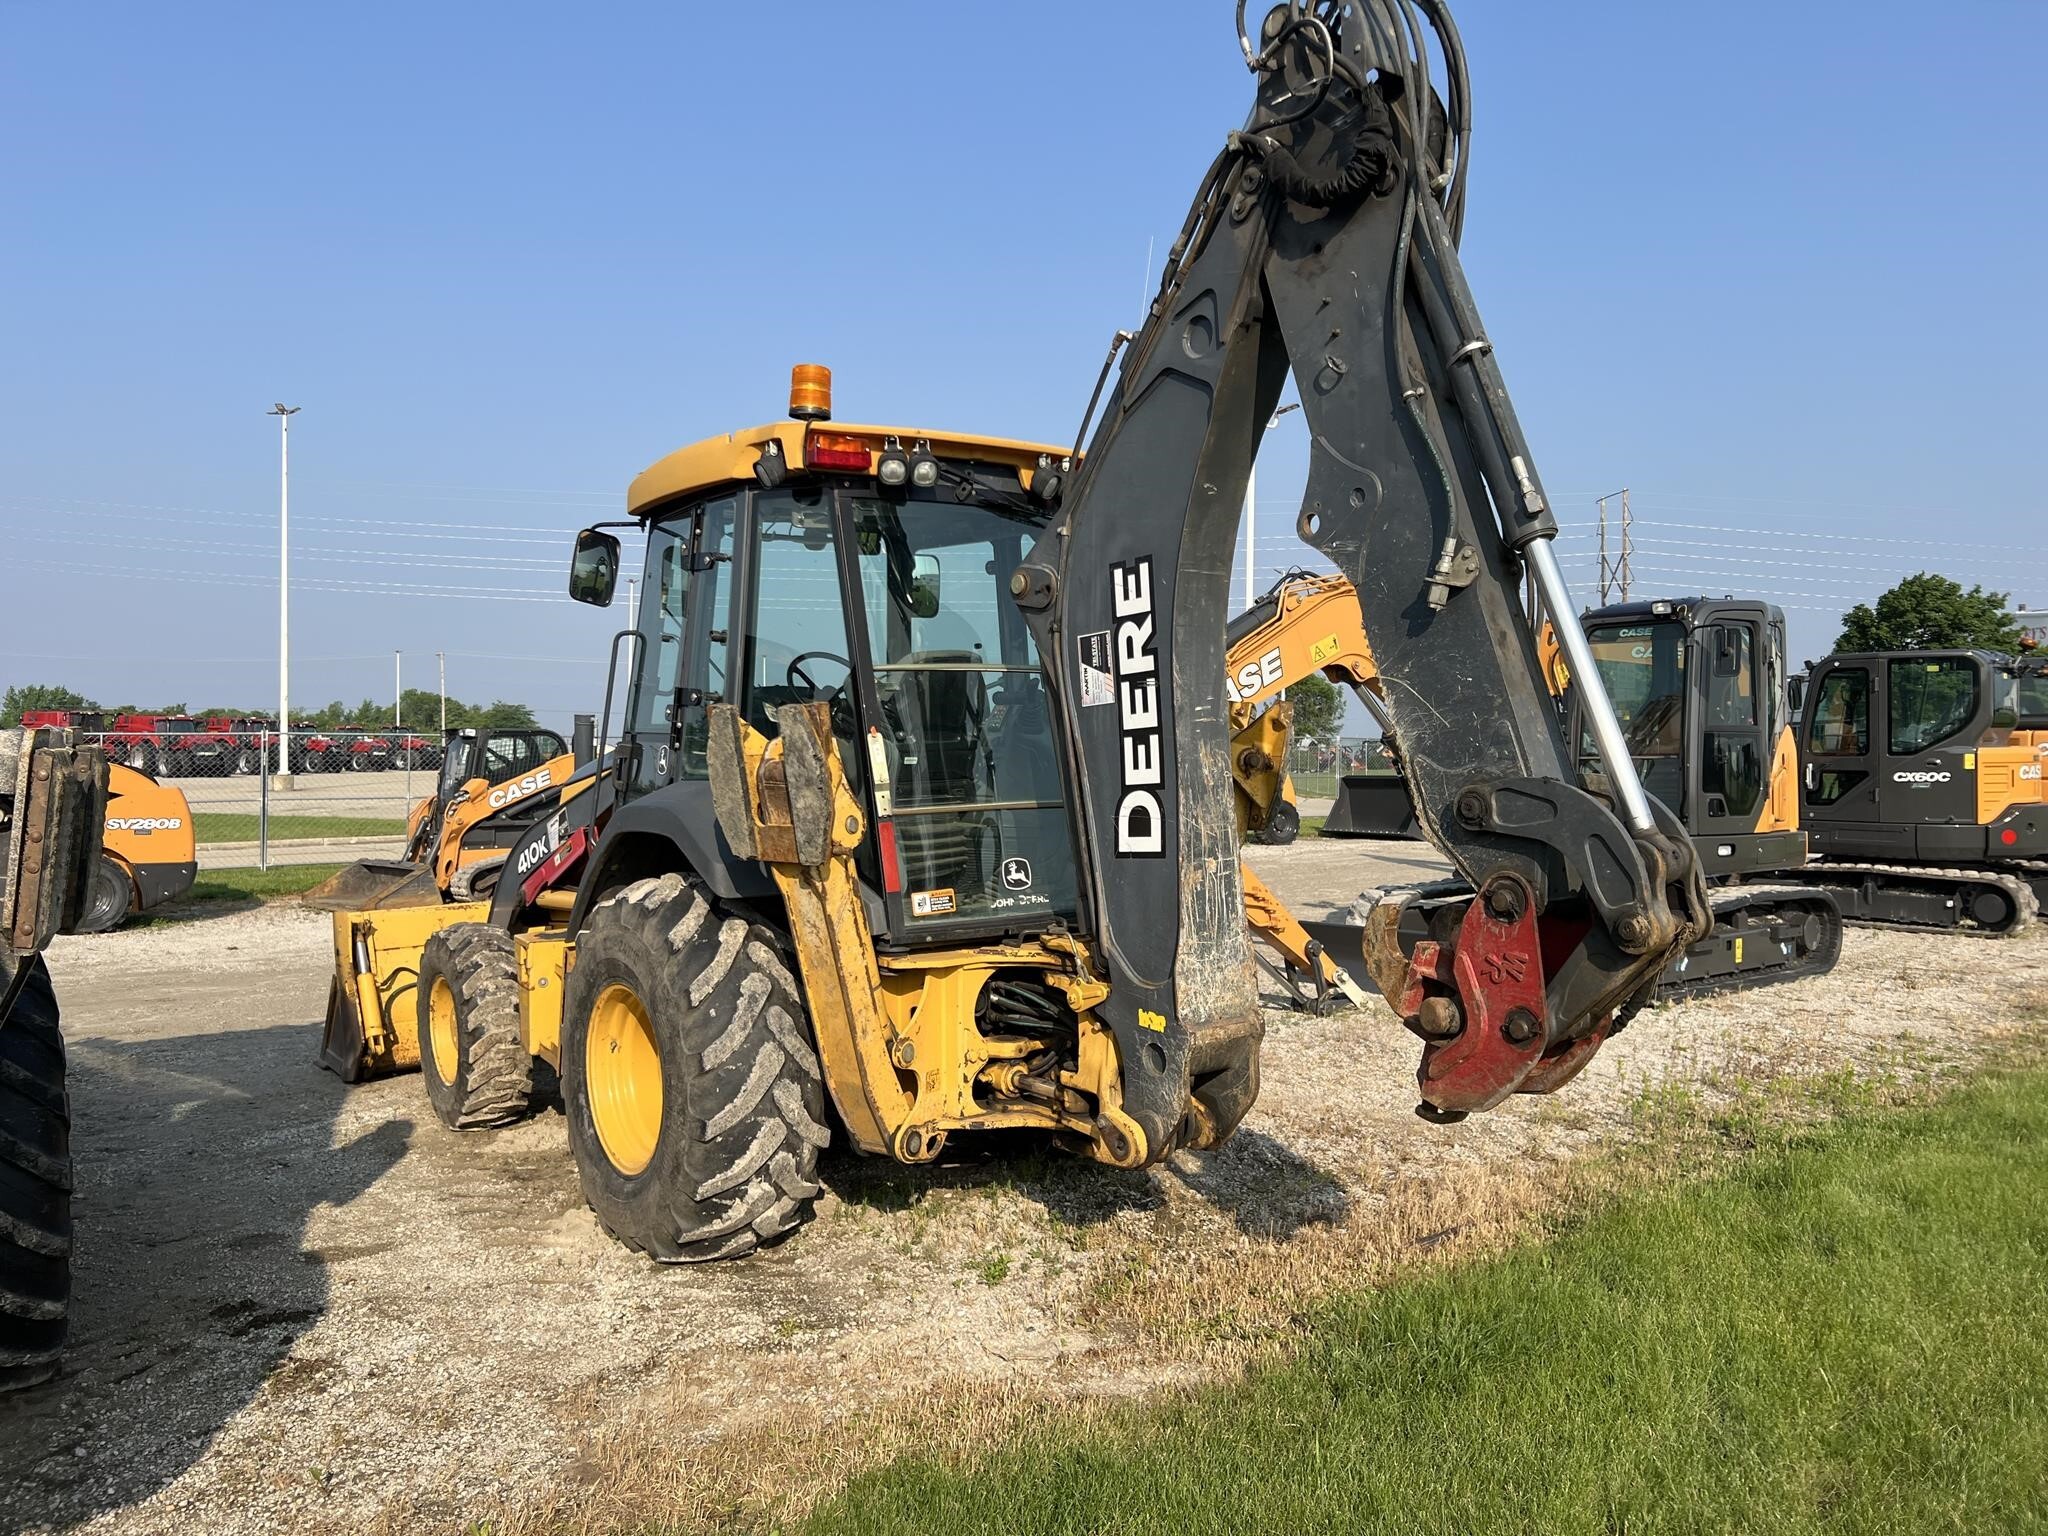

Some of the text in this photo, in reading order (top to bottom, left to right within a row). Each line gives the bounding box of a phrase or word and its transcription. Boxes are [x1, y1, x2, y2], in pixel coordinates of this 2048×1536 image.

[1619, 627, 1653, 637] CASE
[1226, 646, 1284, 701] ASE
[1112, 559, 1163, 855] DEERE
[1893, 771, 1952, 783] CX60C
[2019, 765, 2042, 780] CAS
[488, 768, 552, 809] CASE
[106, 818, 182, 830] SV280B
[518, 835, 549, 874] 410K
